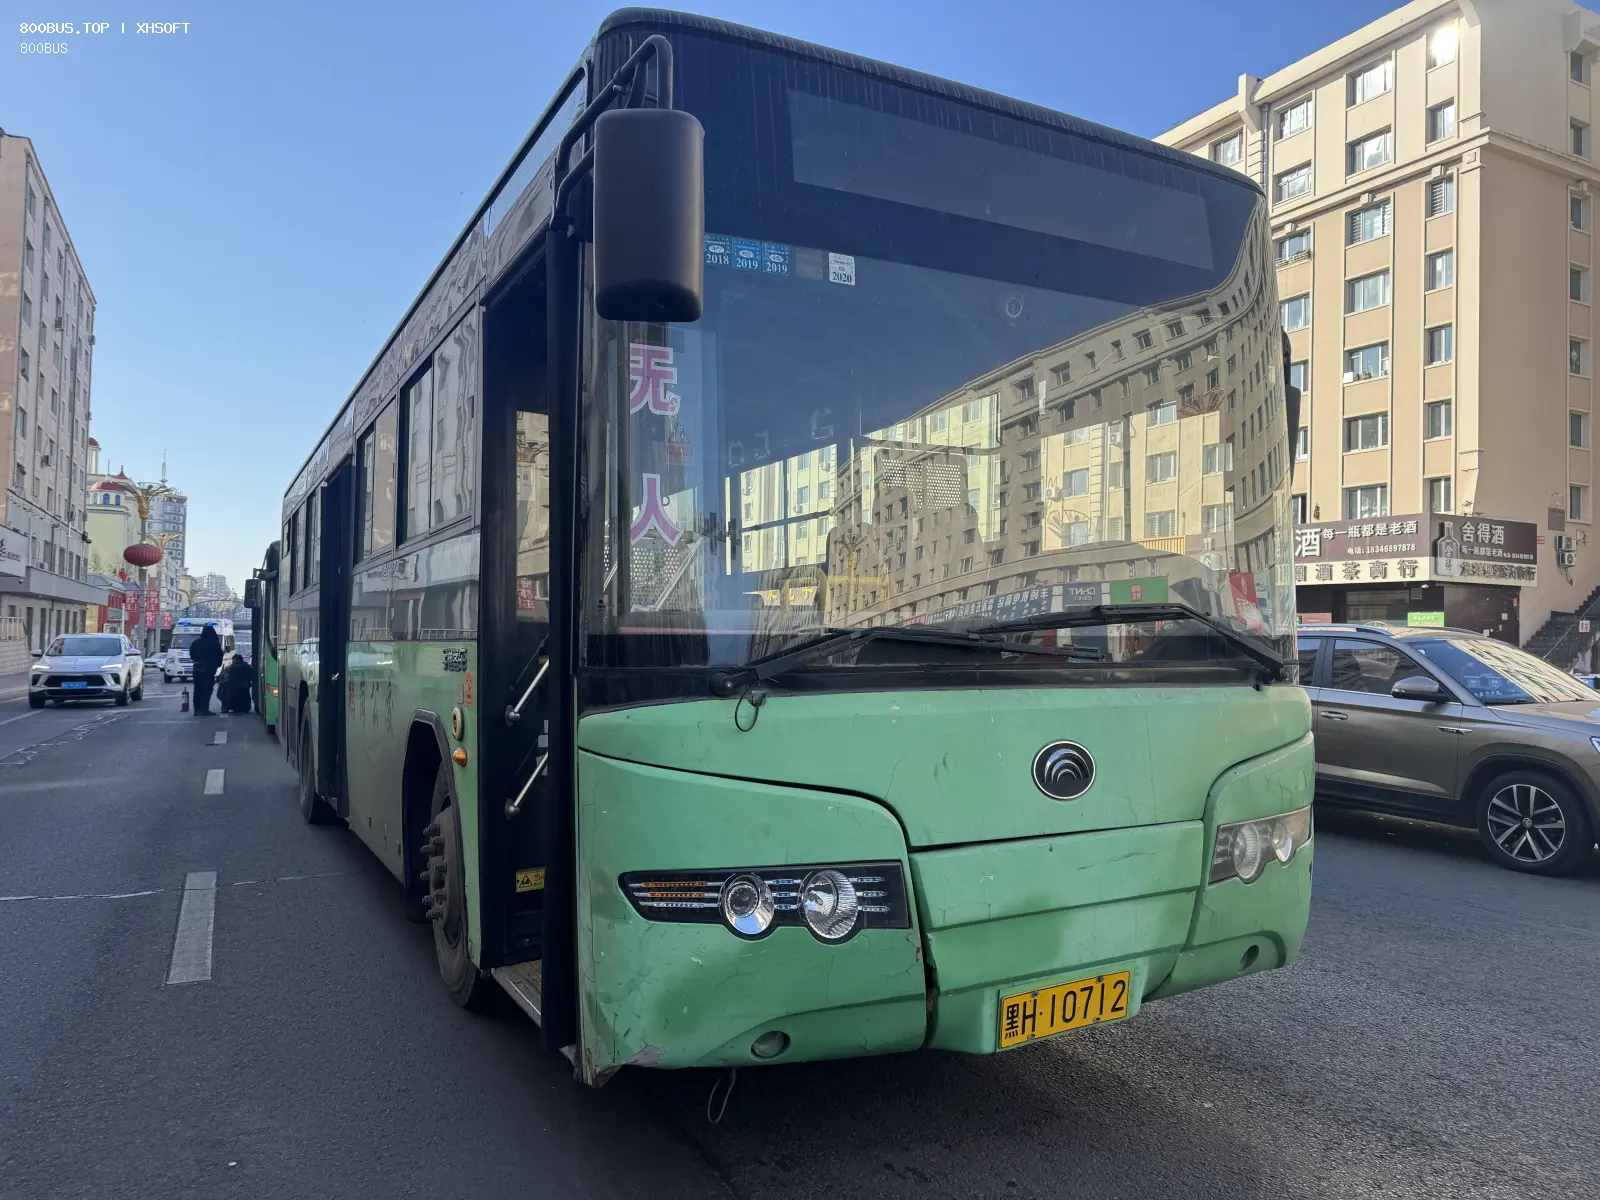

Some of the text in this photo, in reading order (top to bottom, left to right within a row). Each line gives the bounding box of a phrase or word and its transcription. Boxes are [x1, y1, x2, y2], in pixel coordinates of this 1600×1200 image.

[706, 253, 730, 265] 2018
[736, 258, 759, 270] 2019
[766, 262, 788, 274] 2019
[832, 271, 852, 283] 2020
[629, 342, 684, 612] 无人
[1322, 521, 1419, 540] 每一瓶都是老酒
[1461, 521, 1505, 545] 舍得酒
[1295, 527, 1322, 558] 酒
